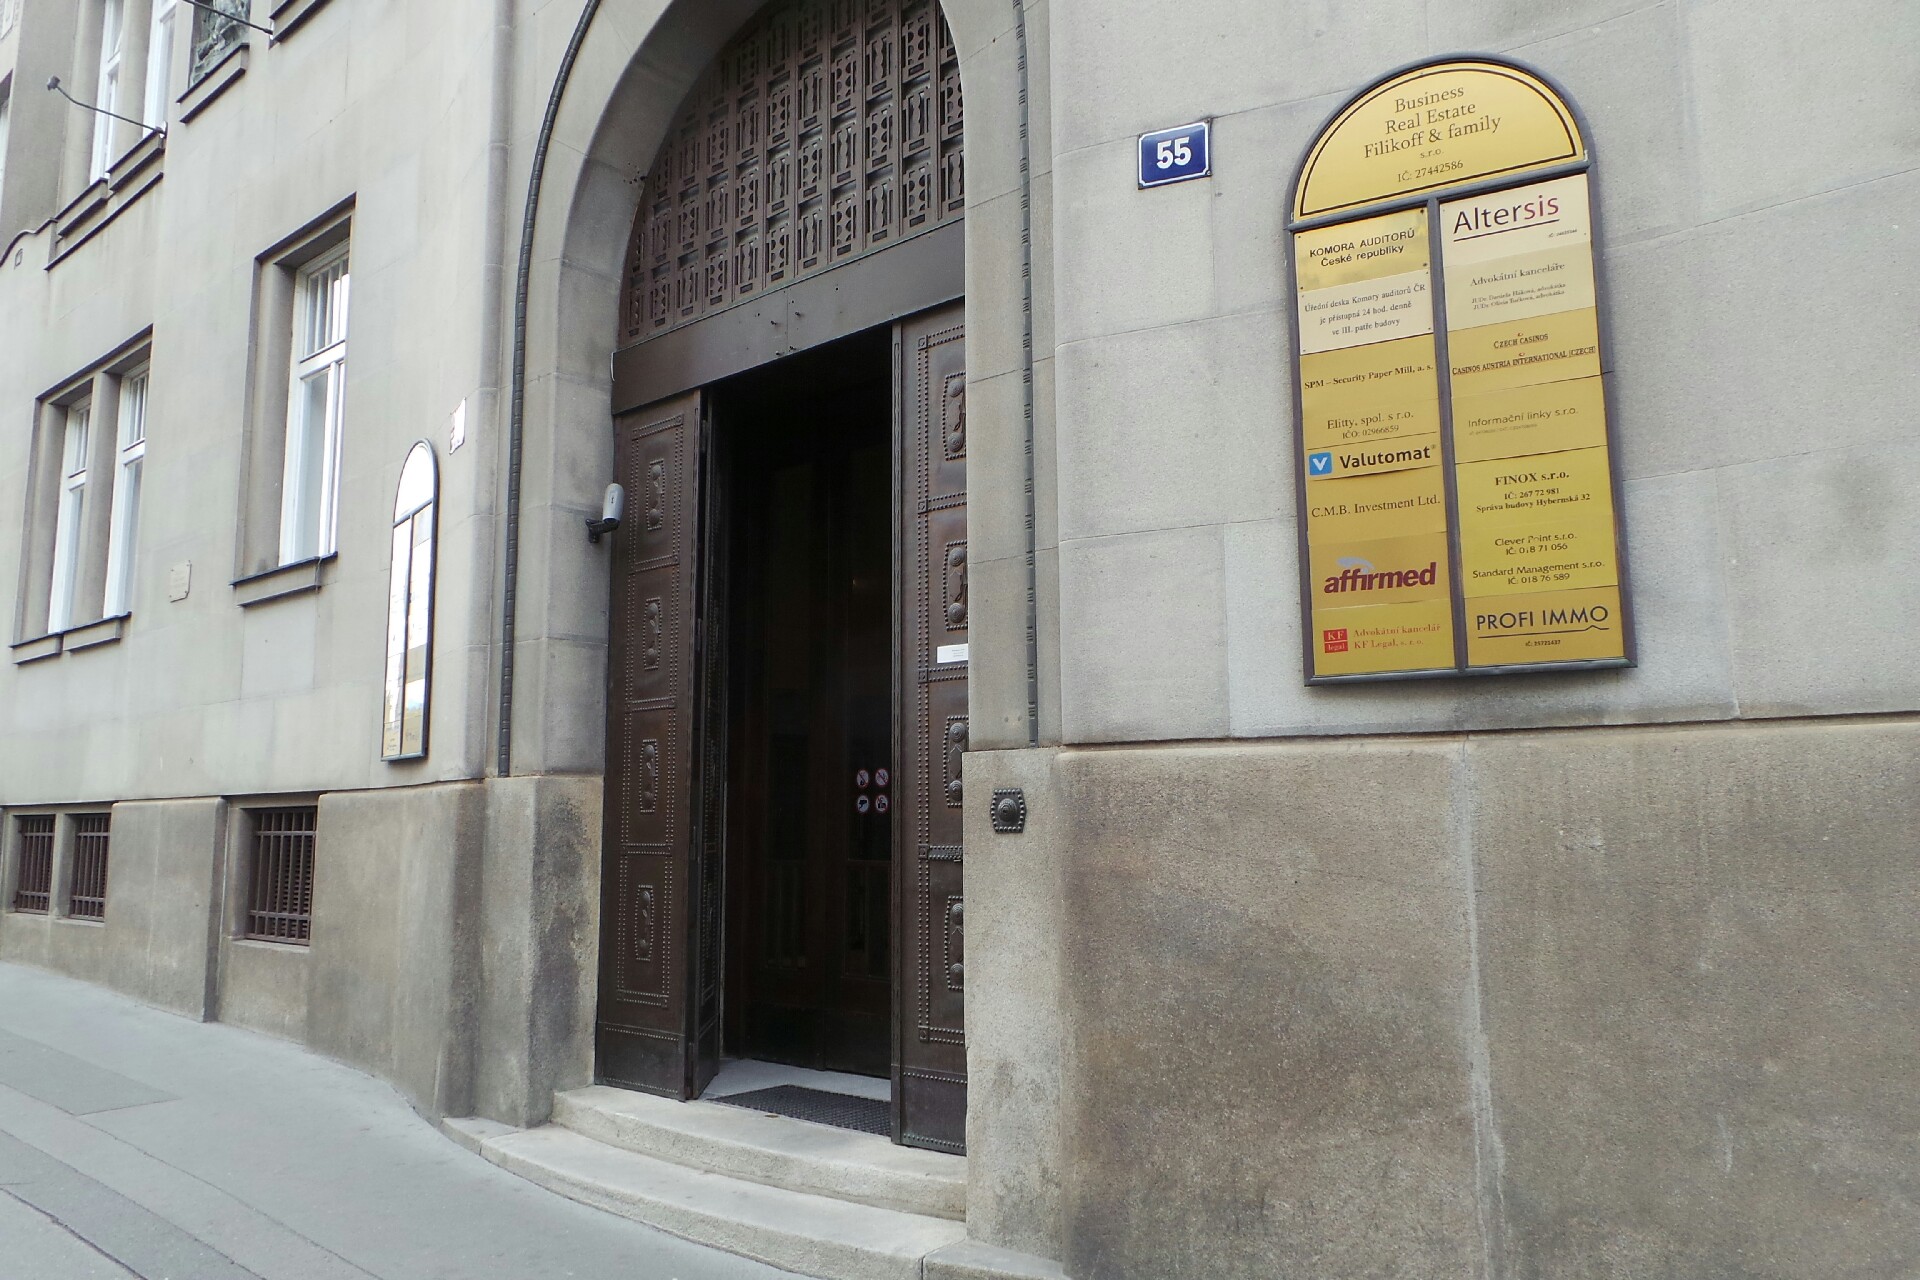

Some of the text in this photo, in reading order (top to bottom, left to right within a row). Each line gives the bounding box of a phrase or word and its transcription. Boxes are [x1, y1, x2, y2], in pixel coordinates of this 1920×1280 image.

[1394, 87, 1464, 113] Business
[1385, 103, 1476, 134] Real Estate
[1364, 115, 1502, 158] Filikoff & family
[1156, 136, 1192, 169] 55
[1420, 148, 1444, 158] s.r.o.
[1397, 160, 1464, 182] IČ: 27442586
[1453, 194, 1559, 234] Altersis
[1309, 228, 1415, 258] KOMORA AUDITORŮ
[1320, 244, 1404, 267] České republiky
[1470, 262, 1565, 287] Advokátní kanceláře
[1304, 283, 1426, 312] Úřední deska Komory auditorů ČR
[1319, 301, 1412, 325] je přístupná 24 hod. denně
[1341, 326, 1353, 334] III.
[1355, 323, 1372, 333] patře
[1374, 318, 1400, 329] budovy
[1494, 333, 1549, 349] CZECH CASINOS
[1452, 365, 1480, 376] CASINOS
[1482, 360, 1511, 371] AUSTRIA
[1513, 351, 1567, 366] INTERNATIONAL
[1304, 379, 1324, 390] SPM
[1333, 374, 1366, 386] Security
[1368, 369, 1393, 381] Paper
[1394, 365, 1416, 376] Mill,
[1360, 413, 1385, 427] spol.
[1388, 413, 1394, 421] s
[1396, 411, 1414, 420] r.o.
[1468, 407, 1578, 428] Informační linky s.r.o.
[1342, 430, 1360, 440] IČO:
[1495, 471, 1570, 486] FINOX s.r.o.
[1476, 493, 1591, 513] Správa budovy Hybernská 32
[1504, 491, 1517, 500] IČ:
[1520, 489, 1533, 498] 267
[1546, 487, 1559, 495] 981
[1311, 494, 1440, 518] C.M.B. Investment Ltd.
[1494, 537, 1525, 547] Clever
[1528, 535, 1551, 544] Point
[1551, 543, 1568, 551] 056
[1324, 561, 1437, 594] affirmed
[1472, 561, 1605, 579] Standard Management s.r.o.
[1521, 575, 1538, 584] 018
[1540, 574, 1551, 582] 76
[1553, 573, 1570, 581] 589
[1476, 605, 1609, 631] PROFI IMMO
[1353, 624, 1441, 637] Advokátní kancelář
[1328, 642, 1345, 652] legal
[1354, 641, 1368, 649] KF
[1372, 639, 1399, 649] Legal,
